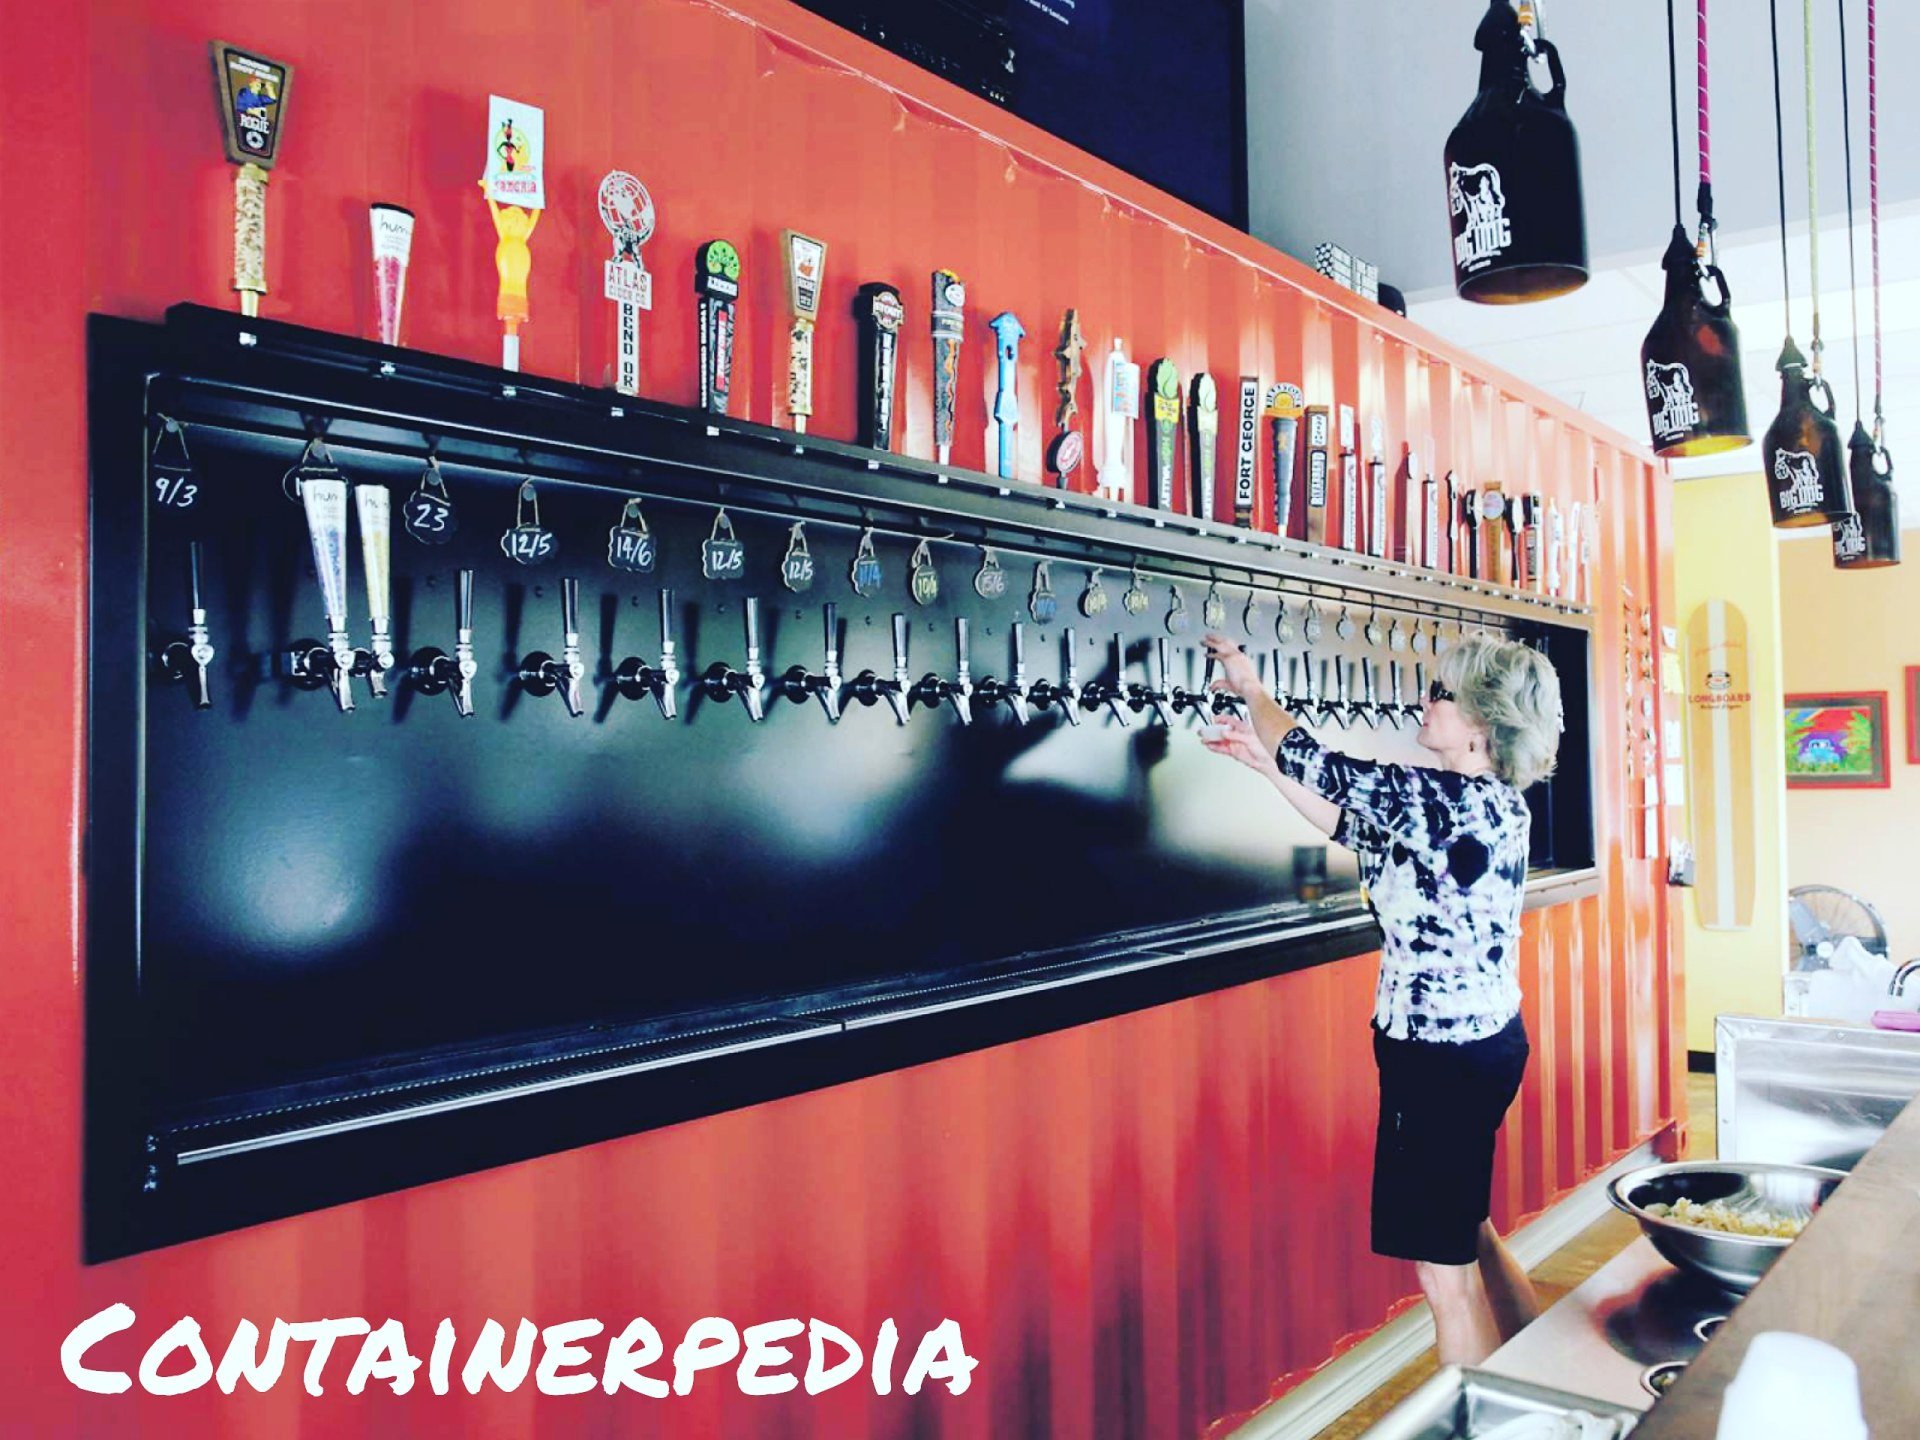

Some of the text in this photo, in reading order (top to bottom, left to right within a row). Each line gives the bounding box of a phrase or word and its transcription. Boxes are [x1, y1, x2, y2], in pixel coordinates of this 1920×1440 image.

[240, 113, 270, 134] ROGUE
[1474, 218, 1511, 257] DOG
[608, 264, 648, 292] ATLAS
[623, 302, 634, 388] BEND OR
[1670, 402, 1699, 429] DOG
[155, 476, 198, 507] 9/3
[1239, 457, 1251, 499] FORT
[1779, 487, 1799, 508] BIG
[1799, 484, 1824, 504] DOG
[413, 504, 450, 532] 23
[511, 533, 553, 557] 12/5
[617, 536, 651, 567] 14/6
[712, 550, 743, 571] 12/5
[789, 559, 814, 580] 12/5
[1688, 692, 1751, 703] LONGBOARD
